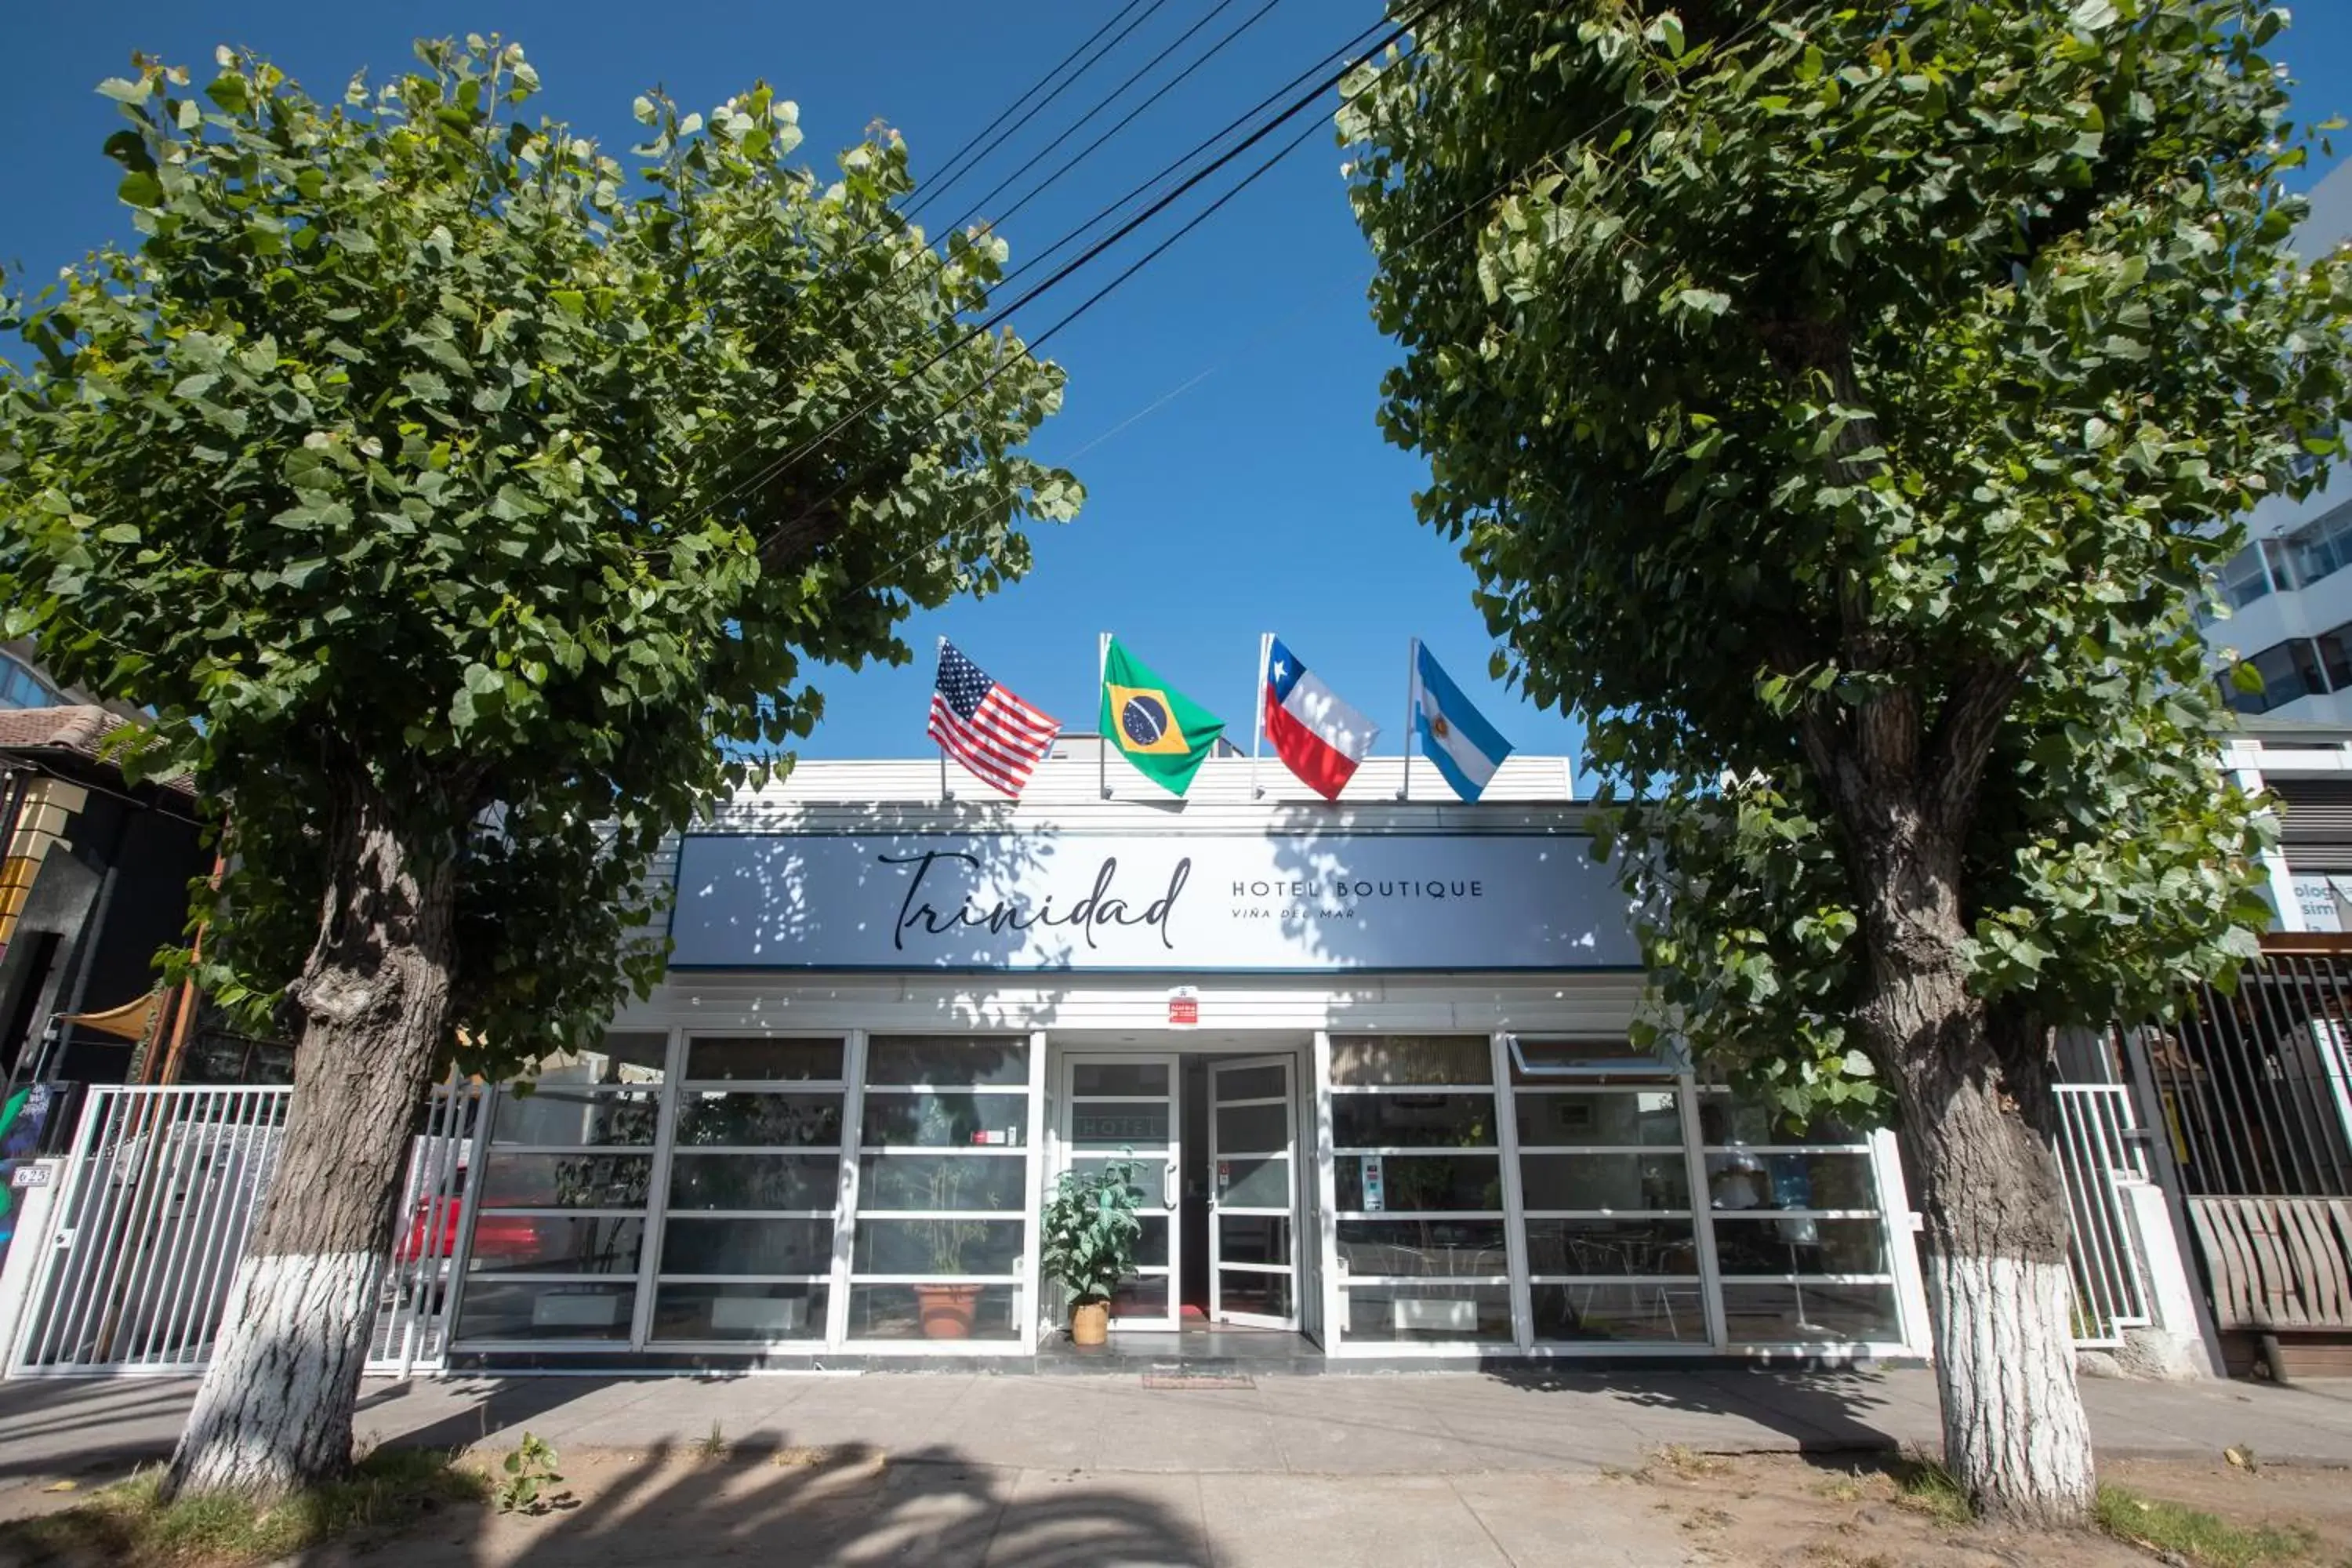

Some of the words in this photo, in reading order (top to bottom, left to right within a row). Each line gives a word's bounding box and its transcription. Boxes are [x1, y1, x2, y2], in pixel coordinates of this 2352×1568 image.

[1232, 880, 1319, 897] HOTEL
[1337, 880, 1483, 898] BOUTIQUE
[877, 850, 1191, 950] Trinidad
[1232, 908, 1270, 918] VIÑA
[1280, 909, 1309, 918] DEL
[1319, 909, 1354, 919] MAR
[1083, 1117, 1157, 1136] HOTEL
[19, 1170, 45, 1181] 625
